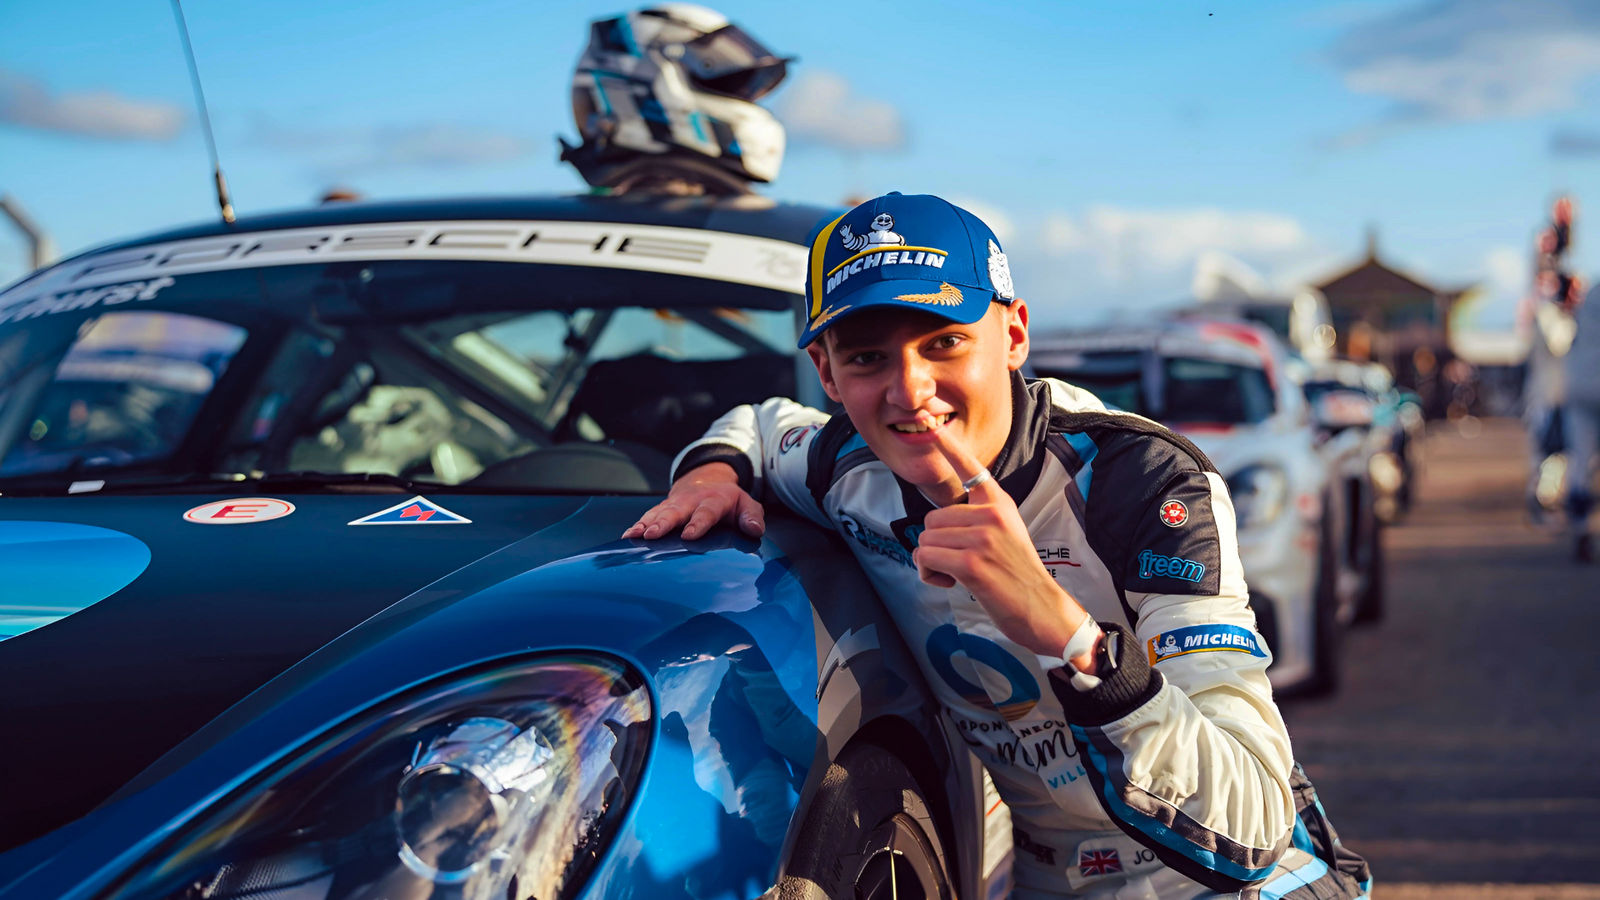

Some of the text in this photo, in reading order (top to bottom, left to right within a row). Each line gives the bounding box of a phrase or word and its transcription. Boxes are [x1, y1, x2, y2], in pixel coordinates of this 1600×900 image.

[69, 229, 711, 283] PORSCHE
[827, 251, 945, 294] MICHELIN
[0, 277, 175, 324] hurst
[1140, 550, 1204, 581] freem
[1184, 633, 1256, 651] MICHELIN
